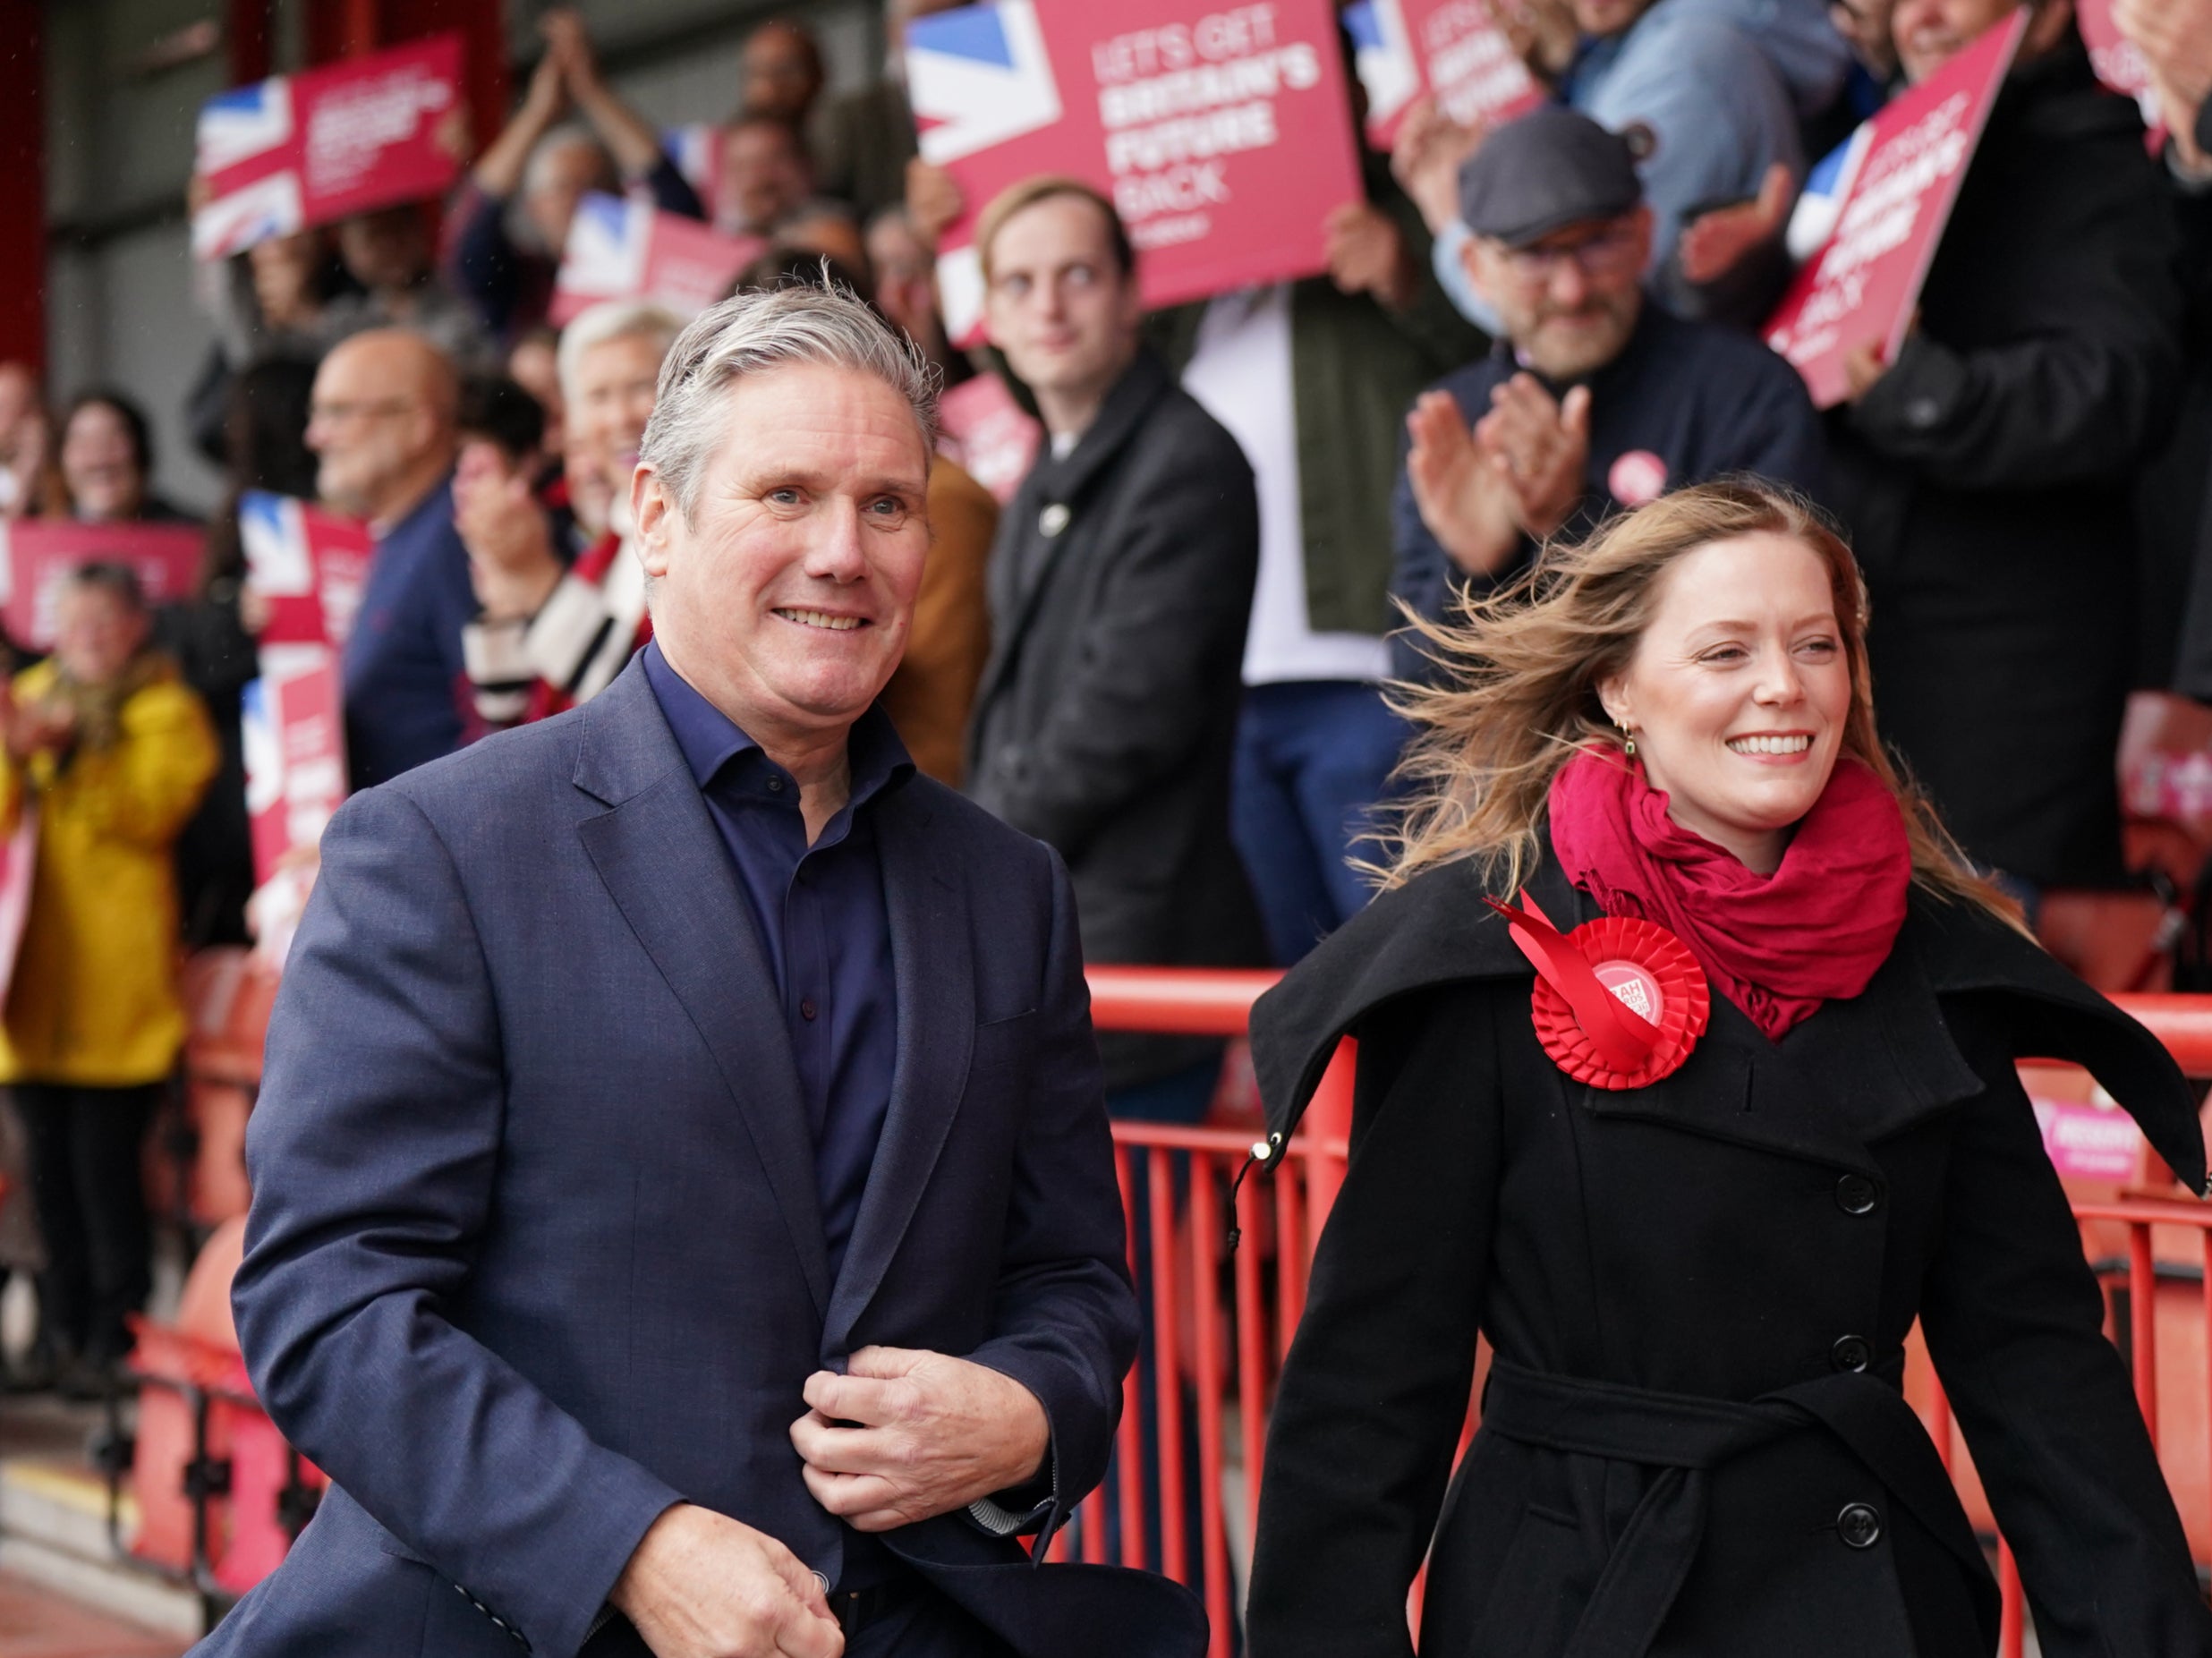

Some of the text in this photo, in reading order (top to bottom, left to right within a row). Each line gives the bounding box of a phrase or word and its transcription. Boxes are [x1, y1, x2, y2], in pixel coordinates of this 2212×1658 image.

[1091, 2, 1278, 86] LET'S GET
[1097, 40, 1322, 131] BRITAIN'S
[1104, 98, 1280, 176] FUTURE
[1112, 155, 1233, 224] BACK
